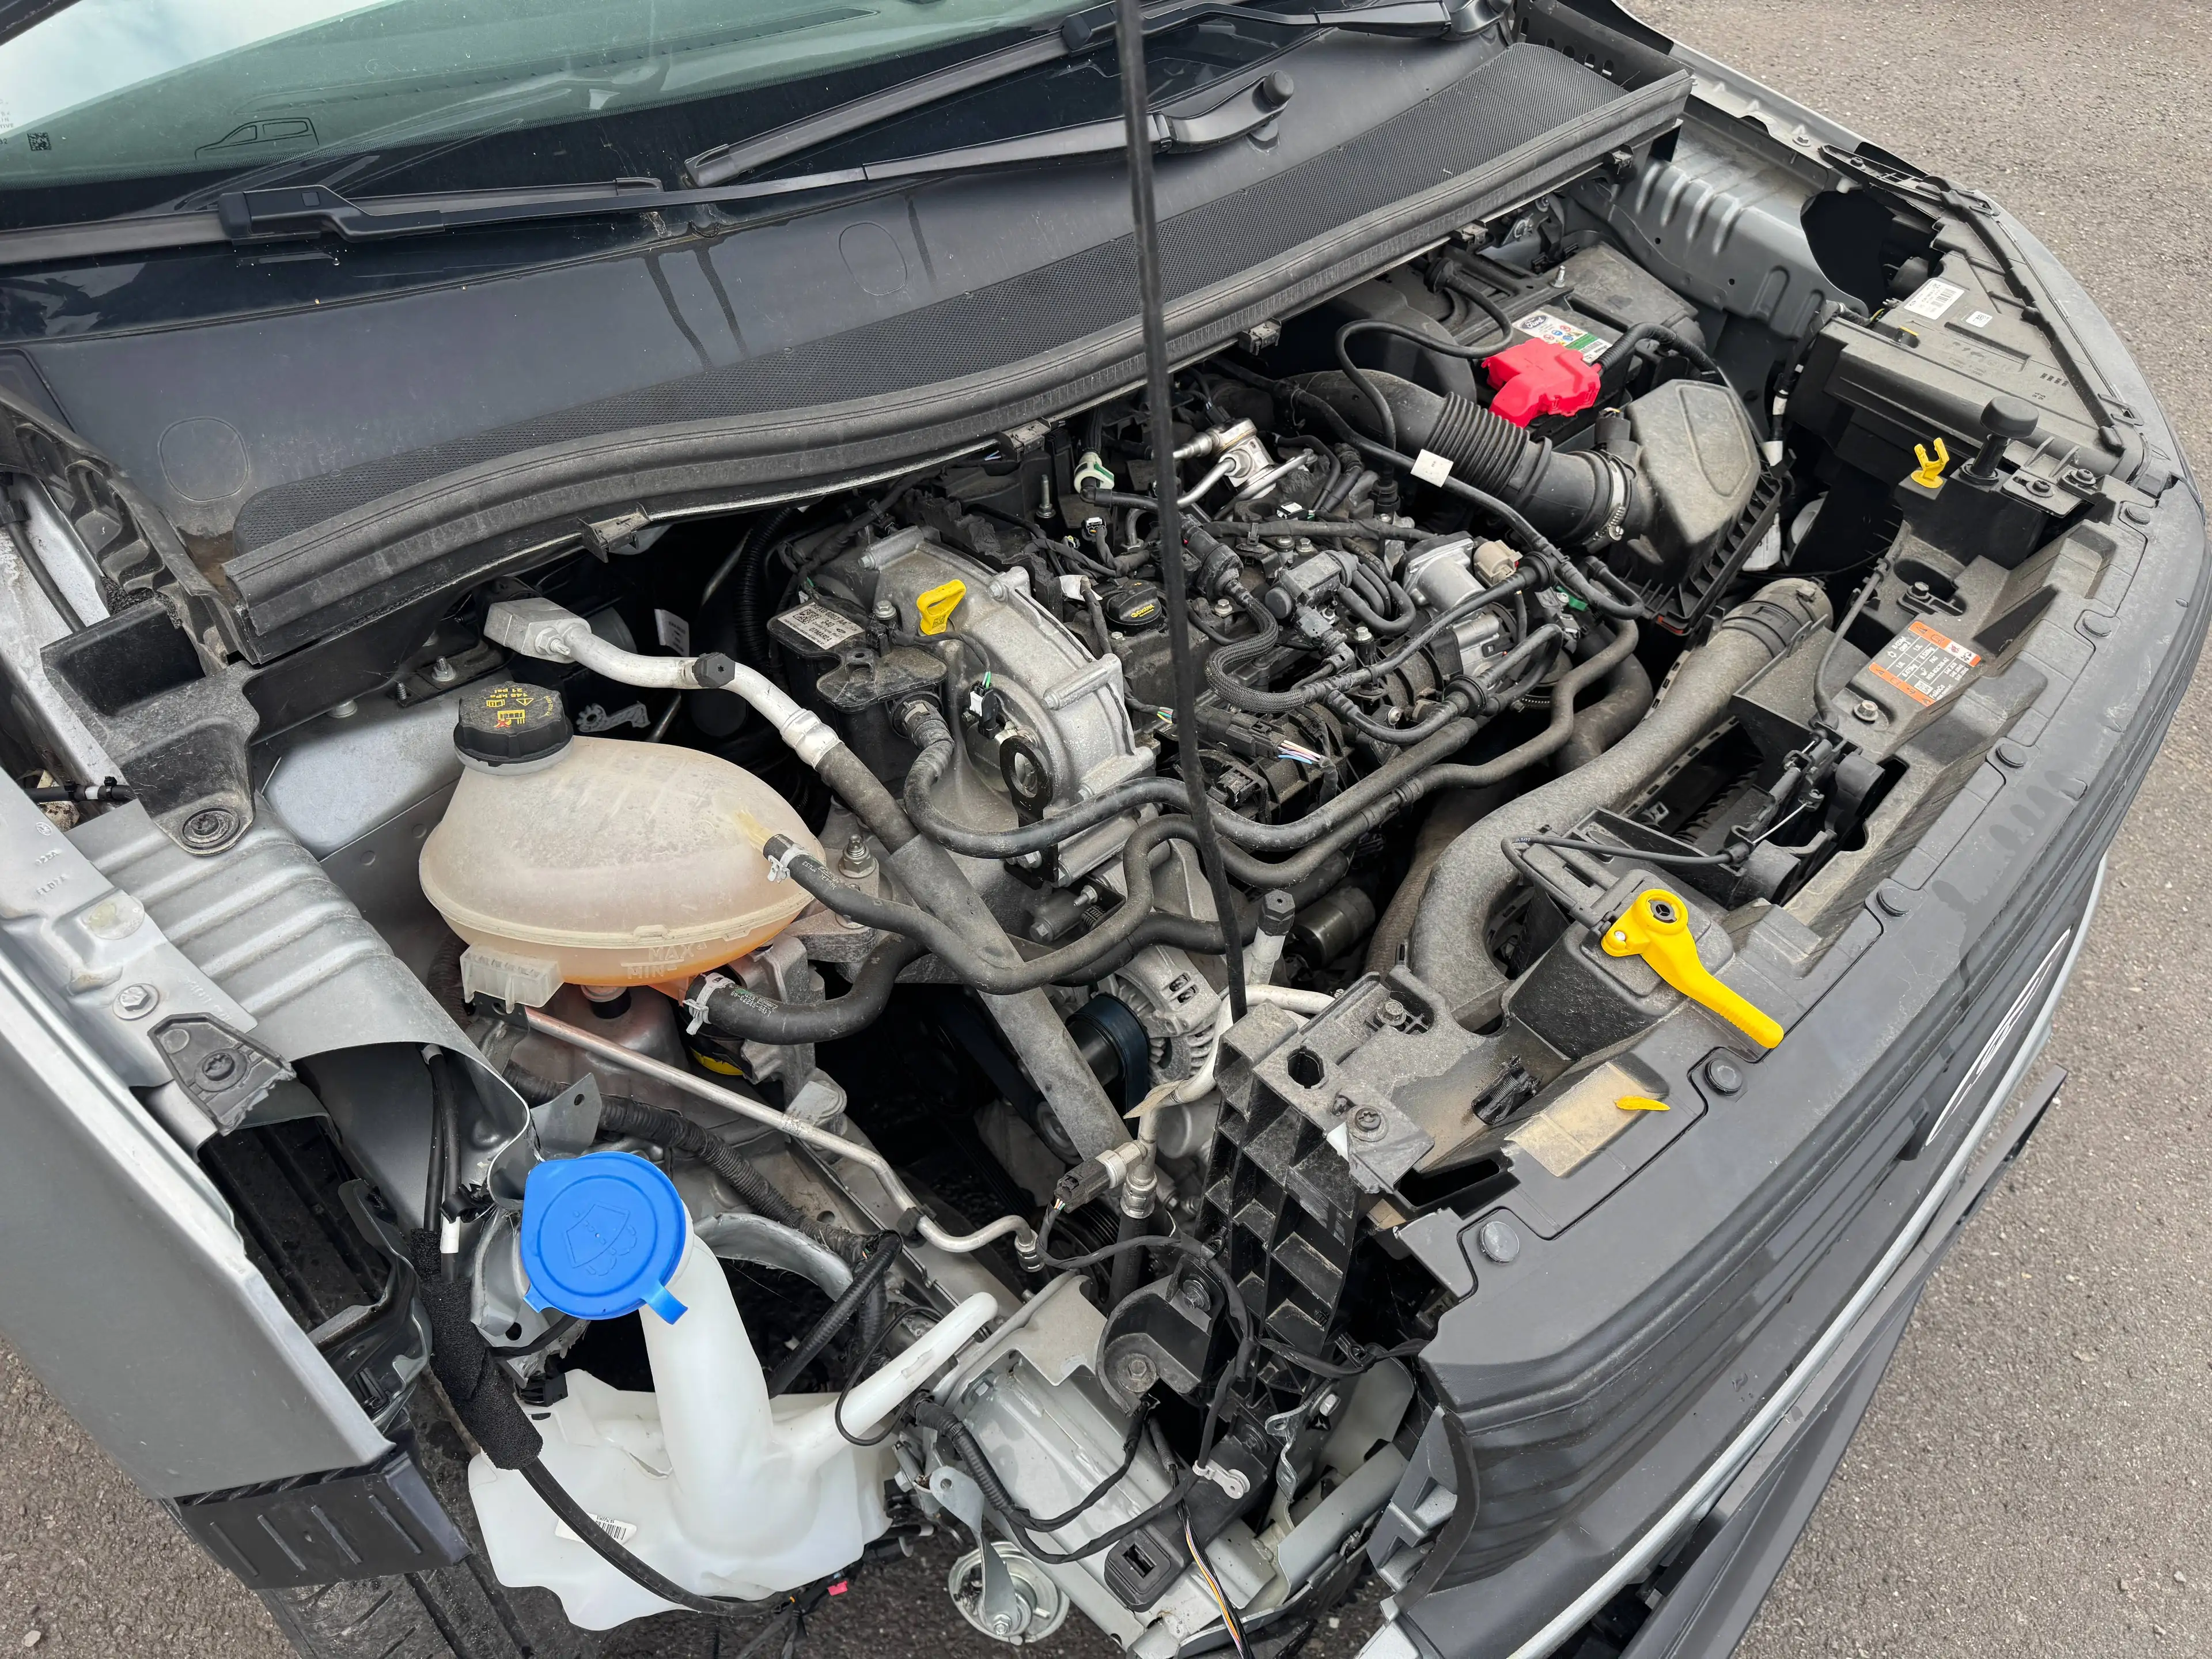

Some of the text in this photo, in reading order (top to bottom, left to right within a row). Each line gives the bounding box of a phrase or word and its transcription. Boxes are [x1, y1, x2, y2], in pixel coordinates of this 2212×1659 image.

[1525, 316, 1544, 328] Ford
[1136, 604, 1154, 615] Castrol
[1929, 684, 1946, 698] FoMoCo
[649, 942, 695, 961] MAX
[627, 965, 664, 979] MIN
